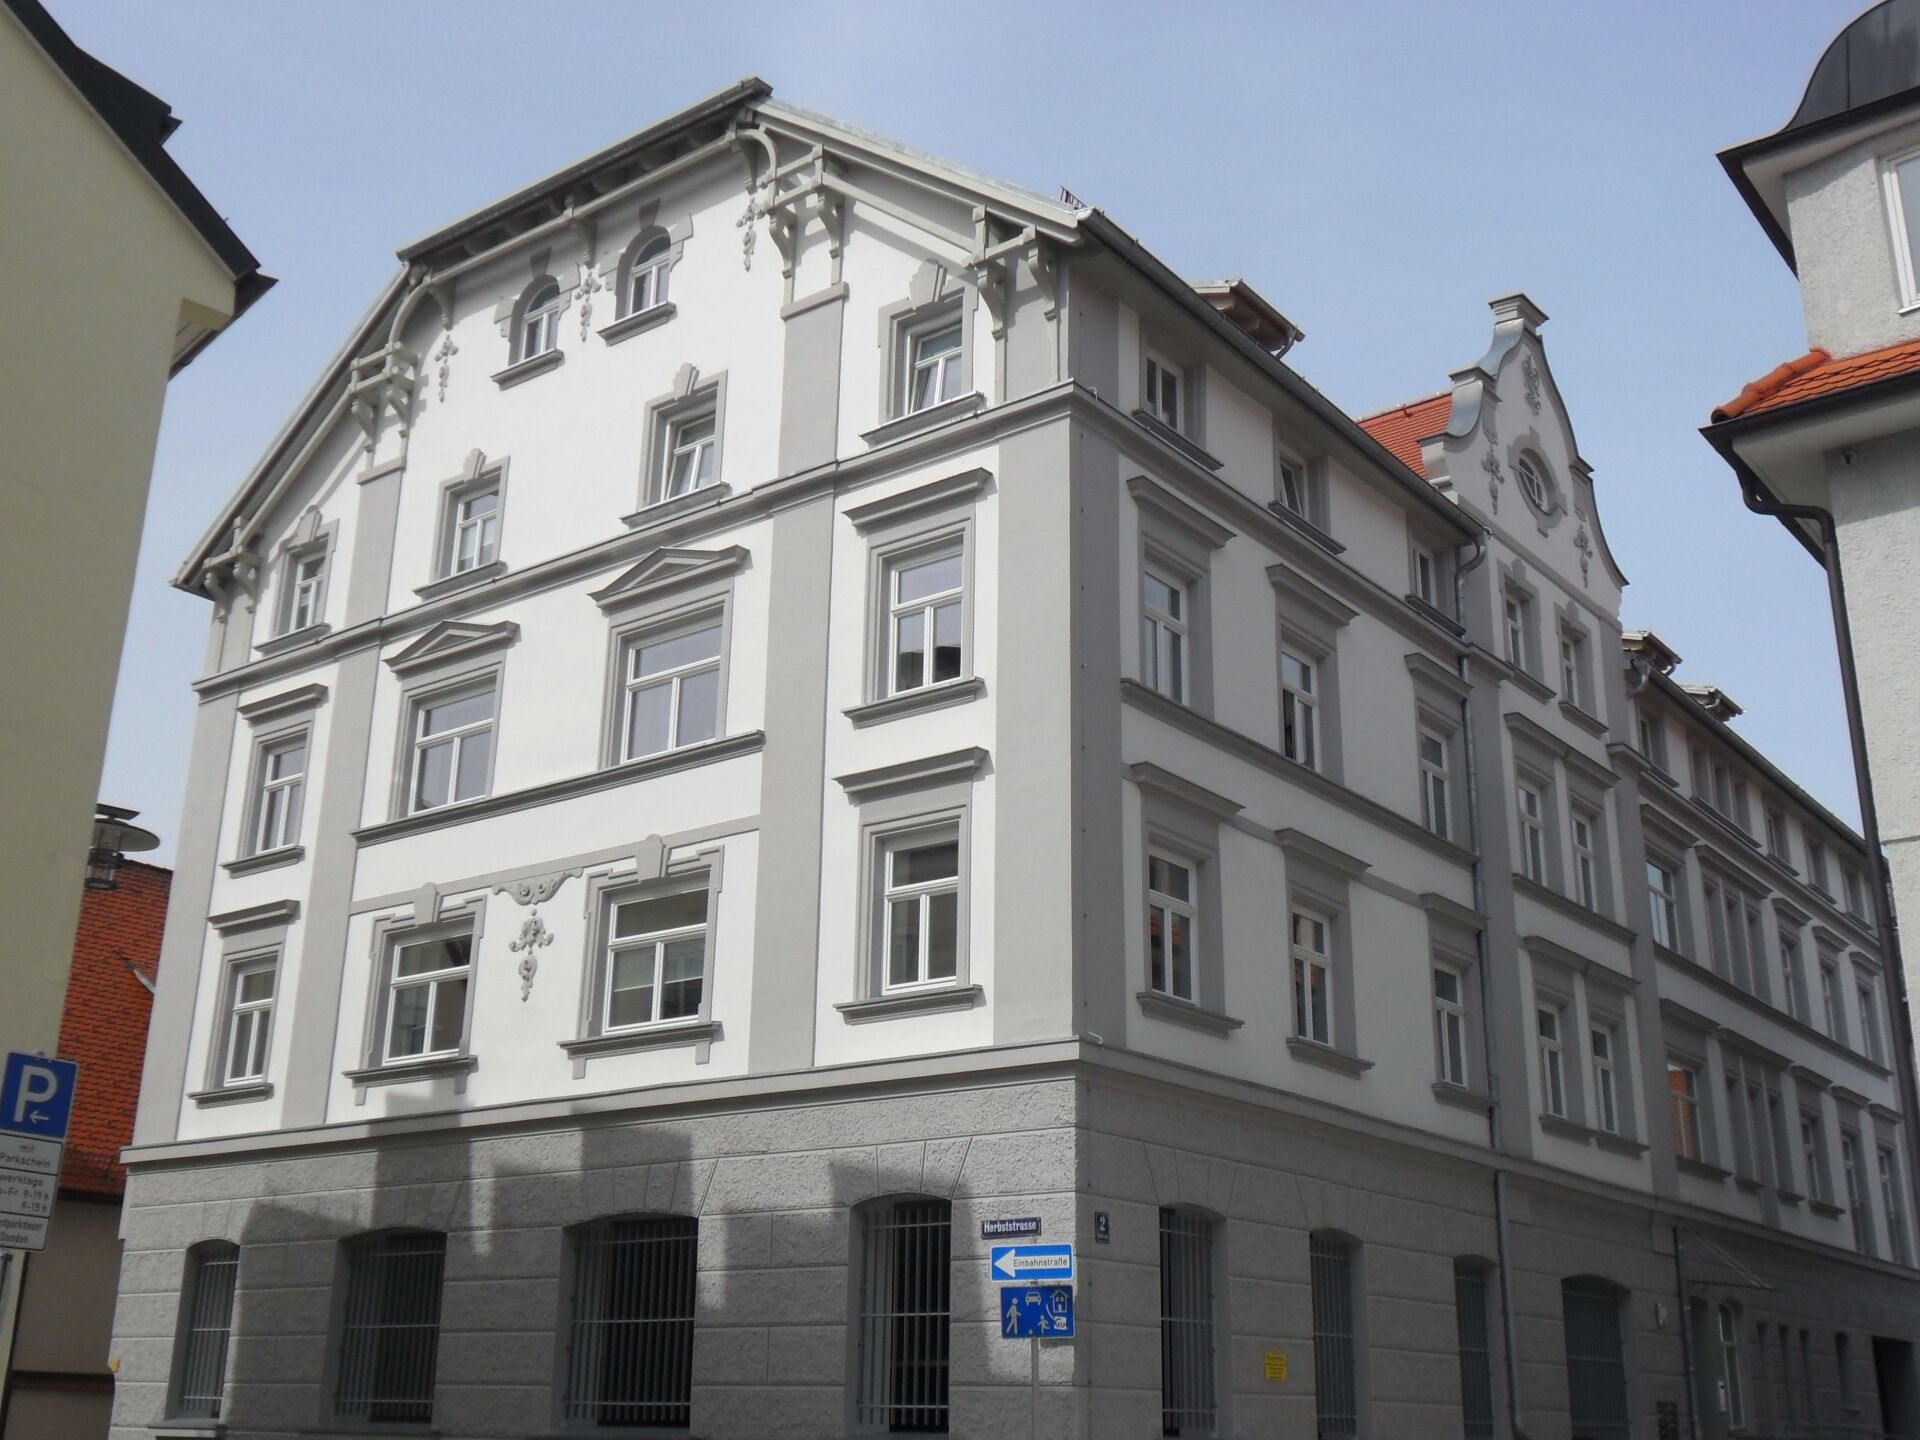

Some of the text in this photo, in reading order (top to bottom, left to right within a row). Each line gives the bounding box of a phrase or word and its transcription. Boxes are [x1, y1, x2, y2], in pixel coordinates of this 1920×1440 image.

[13, 1064, 57, 1123] P
[0, 1152, 51, 1169] Parkschein
[984, 1219, 1037, 1234] Herbststrasse
[1099, 1215, 1106, 1232] 2
[1014, 1256, 1068, 1269] Einbahnstraße
